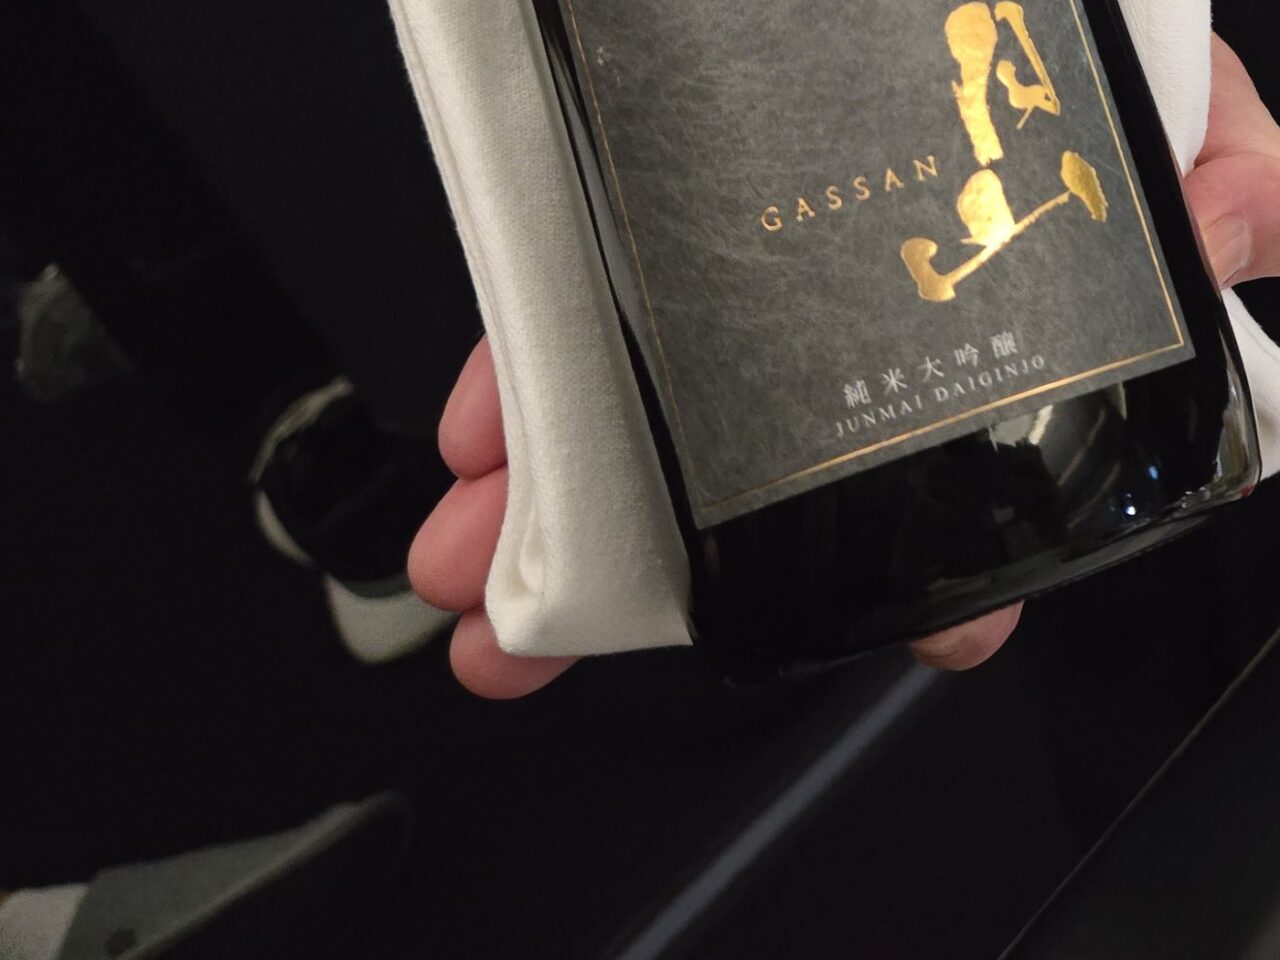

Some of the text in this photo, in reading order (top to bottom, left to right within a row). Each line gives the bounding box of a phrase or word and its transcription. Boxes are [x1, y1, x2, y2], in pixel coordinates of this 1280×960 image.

[760, 155, 938, 232] GASSAN
[835, 355, 1046, 439] JUNMAI DAIGINJO
[843, 330, 1019, 408] 純米大吟醸
